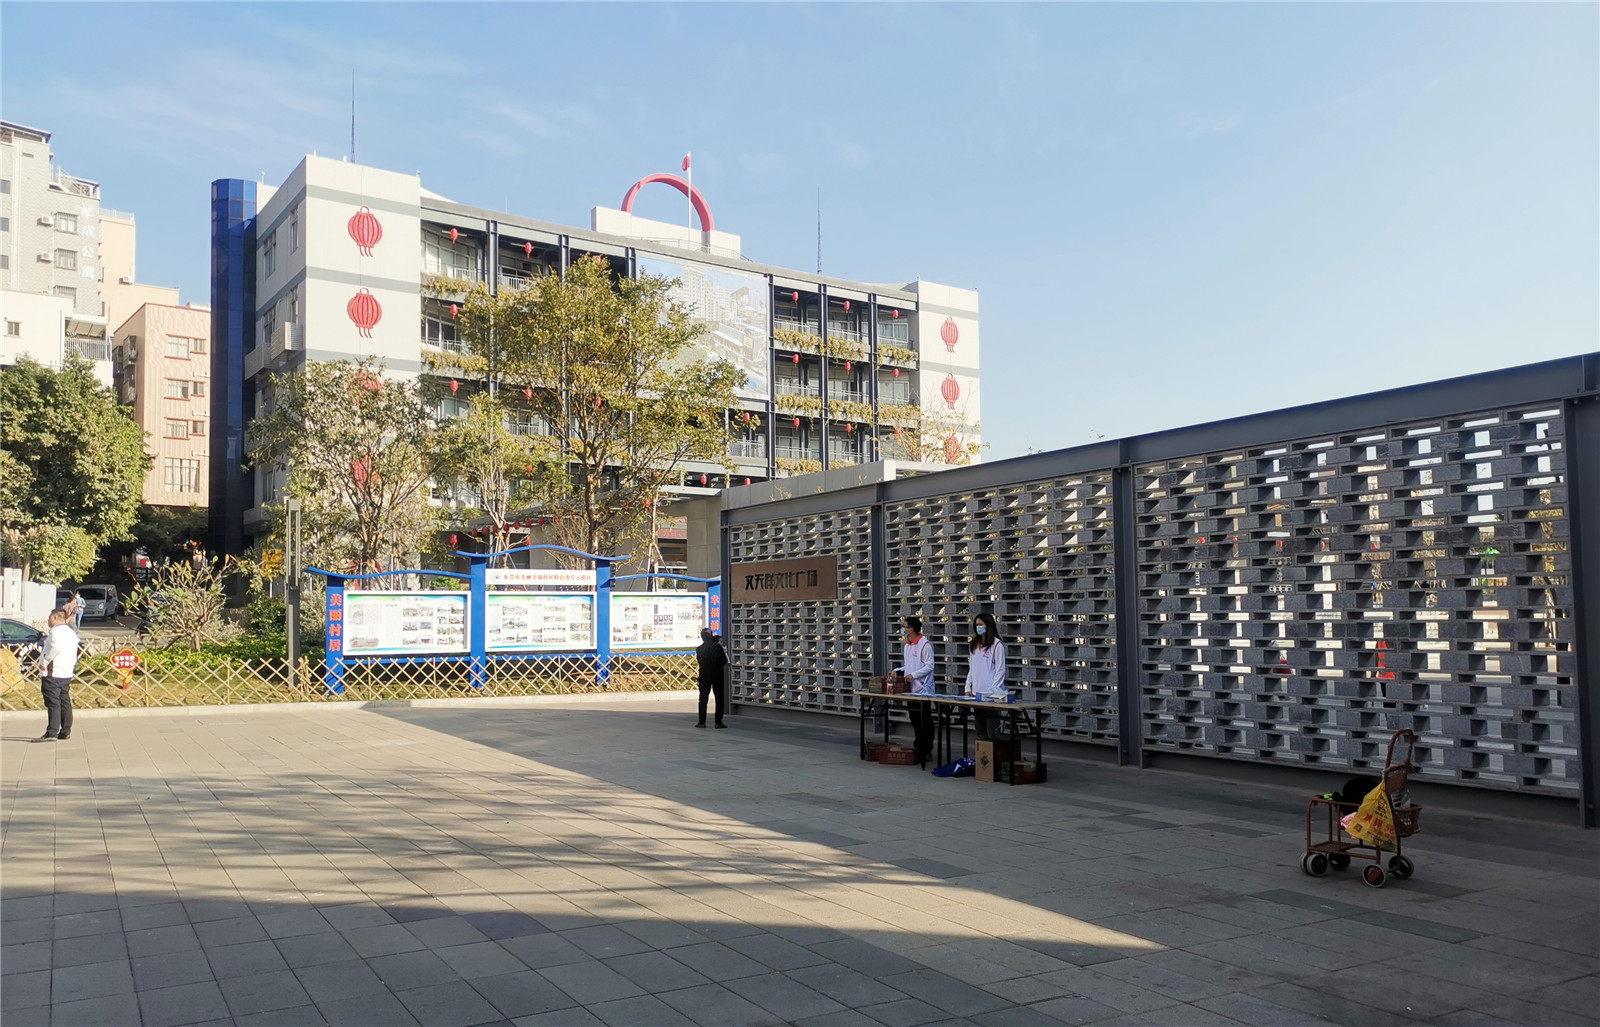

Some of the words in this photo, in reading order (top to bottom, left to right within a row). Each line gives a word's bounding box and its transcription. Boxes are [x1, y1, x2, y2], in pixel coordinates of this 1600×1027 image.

[745, 570, 818, 590] 文天祥文化广场
[328, 593, 342, 652] 美丽村居
